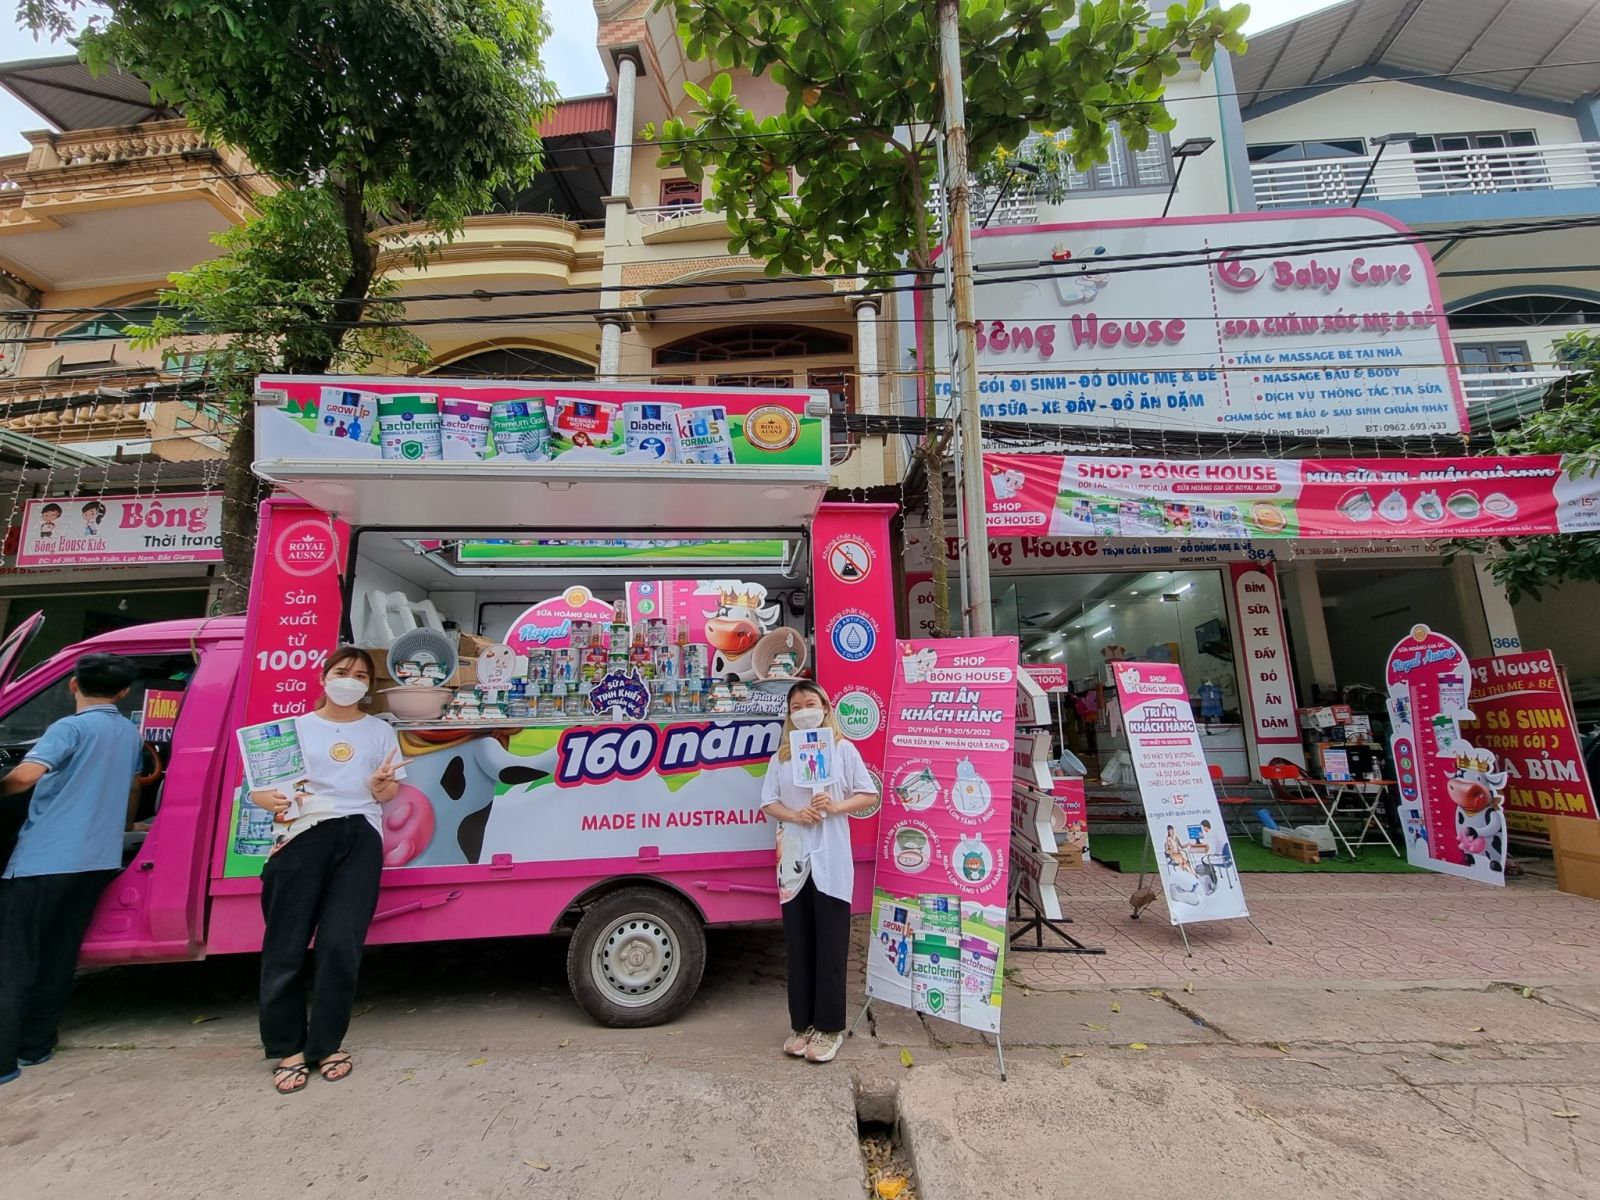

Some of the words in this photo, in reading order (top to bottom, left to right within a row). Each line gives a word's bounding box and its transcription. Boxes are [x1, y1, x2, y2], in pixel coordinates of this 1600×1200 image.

[1273, 259, 1341, 290] Baby
[1351, 257, 1412, 284] Care
[1224, 319, 1261, 336] SPA
[1263, 312, 1320, 334] CHĂM
[1412, 304, 1436, 327] BÉ
[1069, 312, 1186, 347] House
[1265, 353, 1275, 363] &
[1278, 350, 1335, 363] MASSAGE
[1338, 348, 1353, 360] BÉ
[1355, 349, 1374, 361] TẠI
[1376, 346, 1402, 358] NHÀ
[979, 376, 1005, 394] GÓI
[1009, 379, 1027, 393] ĐI
[1031, 376, 1066, 391] SINH
[1154, 371, 1178, 387] MẸ
[1181, 371, 1193, 383] &
[1197, 364, 1217, 382] BÉ
[1263, 371, 1322, 384] MASSAGE
[1354, 369, 1364, 379] &
[1367, 368, 1400, 378] BODY
[1265, 391, 1295, 405] DỊCH
[1298, 391, 1315, 404] VỤ
[1393, 386, 1413, 396] TIA
[1417, 382, 1442, 394] SỮA
[326, 404, 354, 415] GROW
[998, 399, 1028, 417] SỮA
[1042, 401, 1061, 414] XE
[1111, 391, 1135, 411] ĐỒ
[1140, 394, 1162, 409] ĂN
[1167, 392, 1205, 411] DẶM
[566, 416, 600, 426] PREGNANT
[1254, 409, 1275, 421] SÓC
[1320, 409, 1329, 418] &
[1333, 407, 1352, 417] SAU
[1355, 406, 1381, 416] SINH
[379, 419, 441, 432] Lactoferrin
[440, 419, 490, 432] Lactoferrin
[494, 418, 530, 429] Premium
[529, 416, 546, 425] Gold
[630, 420, 673, 431] Diabetic
[675, 413, 720, 439] kids
[1296, 426, 1330, 437] House)
[680, 435, 724, 447] FORMULA
[1077, 463, 1134, 480] SHOP
[1139, 461, 1200, 480] BÔNG
[1205, 465, 1278, 481] HOUSE
[1306, 471, 1344, 483] MUA
[1345, 467, 1378, 483] SỮA
[1419, 465, 1469, 482] NHẬN
[992, 502, 1022, 511] SHOP
[118, 500, 209, 534] Bông
[1004, 515, 1041, 525] HOUSE
[58, 536, 87, 553] House
[88, 537, 107, 551] Kids
[144, 533, 177, 548] Thời
[181, 534, 224, 549] trang
[1020, 536, 1098, 559] House
[1102, 545, 1124, 557] TRỌN
[1126, 544, 1141, 555] GÓI
[1153, 545, 1173, 555] SINH
[1180, 540, 1193, 553] ĐỒ
[1194, 541, 1218, 553] DÙNG
[1218, 543, 1232, 554] MẸ
[122, 554, 137, 563] Lục
[172, 553, 195, 562] Giang
[288, 552, 325, 560] AUSNZ
[1249, 548, 1276, 560] 364
[1360, 547, 1385, 555] THANH
[1244, 581, 1266, 593] BỈM
[284, 589, 317, 605] Sản
[535, 609, 553, 617] SỮA
[553, 610, 583, 619] HOÀNG
[584, 611, 598, 619] GIA
[599, 611, 611, 619] ÚC
[1247, 603, 1271, 615] SỮA
[279, 610, 318, 625] xuất
[519, 618, 571, 643] Royal
[1253, 627, 1270, 637] XE
[287, 632, 308, 647] từ
[1493, 637, 1520, 649] 366
[256, 649, 329, 671] 100%
[953, 656, 986, 667] SHOP
[1491, 658, 1552, 677] House
[930, 671, 962, 681] BÔNG
[965, 671, 1006, 681] HOUSE
[1037, 675, 1064, 684] 100%
[1538, 676, 1555, 689] BÉ
[275, 678, 307, 692] sữa
[607, 680, 625, 689] SỮA
[854, 684, 869, 692] gen
[1139, 684, 1157, 693] BÔNG
[1158, 685, 1181, 693] HOUSE
[597, 690, 617, 702] TINH
[618, 686, 642, 701] KHIẾT
[930, 691, 955, 704] TRI
[955, 686, 980, 704] ÂN
[1265, 693, 1282, 705] ĂN
[272, 701, 306, 714] tươi
[855, 707, 869, 716] NO
[900, 704, 955, 721] KHÁCH
[955, 704, 1003, 723] HÀNG
[1143, 706, 1161, 718] TRI
[1161, 702, 1177, 718] ÂN
[847, 716, 869, 725] GMO
[1129, 717, 1165, 733] KHÁCH
[1165, 716, 1195, 733] HÀNG
[1261, 716, 1289, 730] DẶM
[1486, 708, 1511, 729] SƠ
[1515, 708, 1566, 729] SINH
[923, 726, 943, 734] NHẤT
[944, 727, 991, 736] 19-20/5/2022
[662, 718, 783, 768] năm
[945, 740, 967, 749] NHẬN
[984, 742, 1005, 750] SANG
[1523, 732, 1546, 748] GÓI
[560, 726, 656, 782] 160
[1525, 750, 1581, 783] BỈM
[1172, 794, 1185, 805] 15
[1508, 785, 1536, 808] ĂN
[1536, 787, 1588, 817] DẶM
[581, 813, 636, 831] MADE
[641, 812, 661, 828] IN
[666, 809, 768, 827] AUSTRALIA
[912, 962, 961, 979] Lactoferrin
